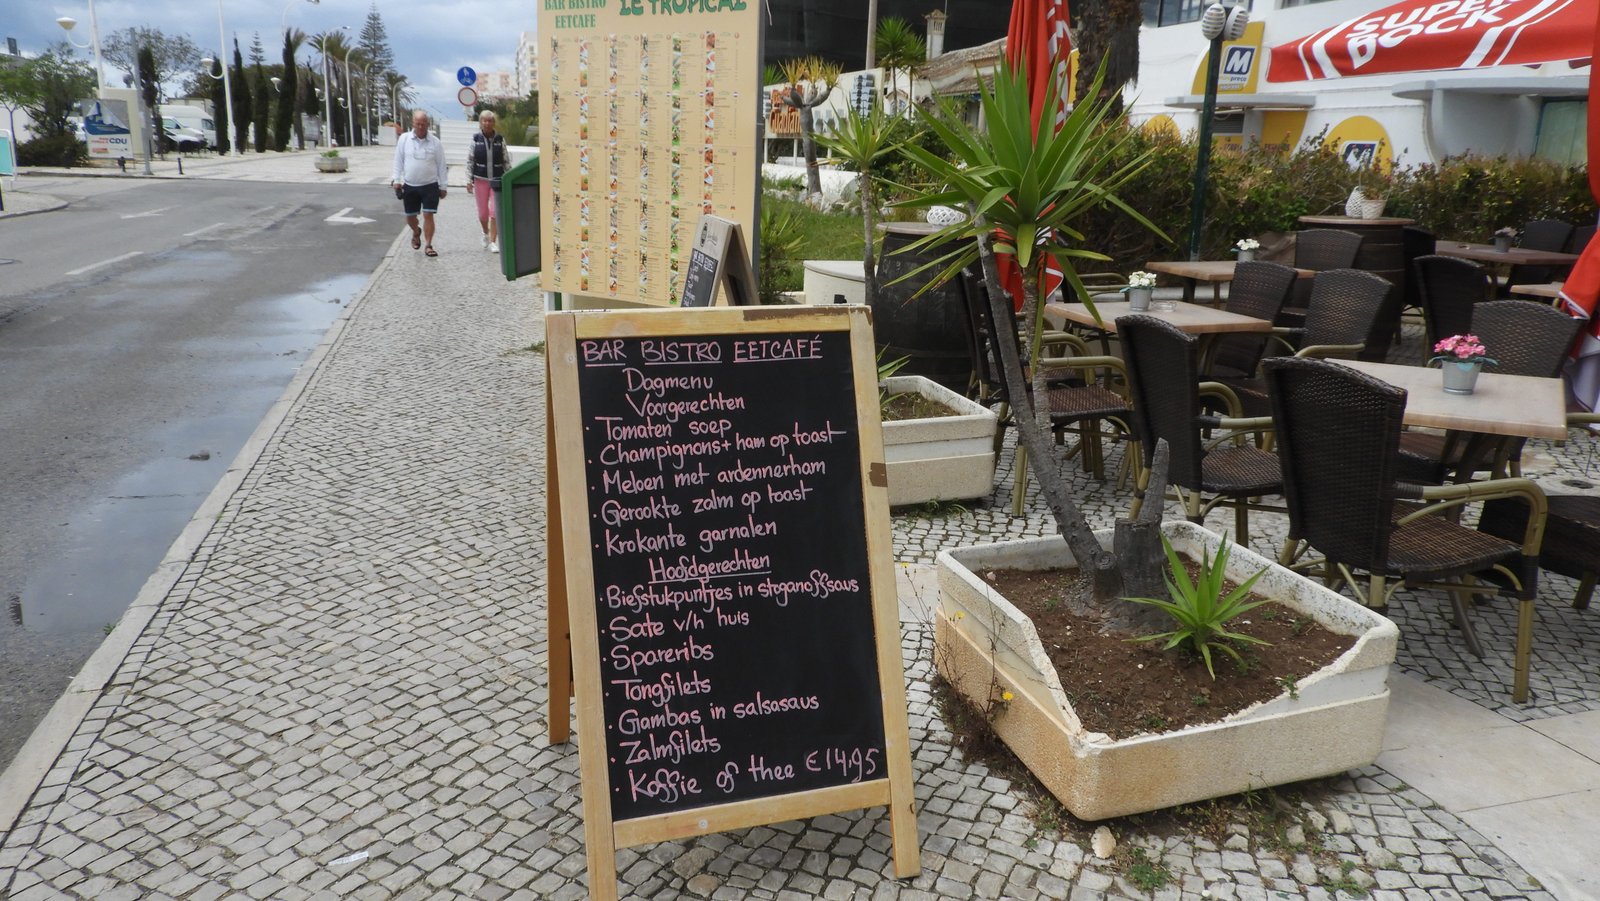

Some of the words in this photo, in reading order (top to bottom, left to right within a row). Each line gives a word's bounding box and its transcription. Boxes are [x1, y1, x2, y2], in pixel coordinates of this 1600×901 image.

[544, 0, 566, 11] BAR
[568, 0, 606, 10] BISTRO
[555, 15, 597, 29] EETCAFE
[619, 0, 645, 16] LE
[651, 0, 748, 15] TROPICAL
[1345, 0, 1520, 38] SUPE
[1226, 50, 1251, 73] M
[109, 137, 128, 145] CDU
[581, 340, 626, 365] BAR
[640, 340, 722, 364] BISTRO
[734, 334, 822, 362] EETCAFÉ
[622, 368, 713, 397] Dagmenu
[626, 392, 744, 422] Voorgerechten
[595, 416, 672, 441] Tomaten
[689, 419, 732, 438] soep
[736, 433, 765, 451] ham
[770, 436, 790, 456] op
[792, 420, 847, 445] toast
[602, 470, 664, 495] Meloen
[674, 462, 710, 487] met
[718, 454, 826, 482] ardennerham
[602, 496, 682, 527] Gerookte
[692, 489, 734, 514] zalm
[742, 492, 761, 514] op
[768, 480, 814, 503] toast
[606, 522, 686, 556] Krokante
[700, 514, 777, 552] garnalen
[648, 549, 770, 583] Hoofdgerechten
[738, 582, 753, 599] in
[609, 612, 665, 642] Sate
[674, 610, 704, 632] v/h
[717, 607, 750, 626] huis
[611, 636, 714, 675] Spareribs
[611, 670, 712, 707] Tongfilets
[618, 704, 701, 736] Gambas
[710, 702, 726, 720] in
[734, 692, 820, 719] salsasaus
[620, 724, 722, 765] Zalmfilets
[628, 768, 702, 802] Koffie
[716, 762, 739, 793] of
[748, 754, 795, 782] thee
